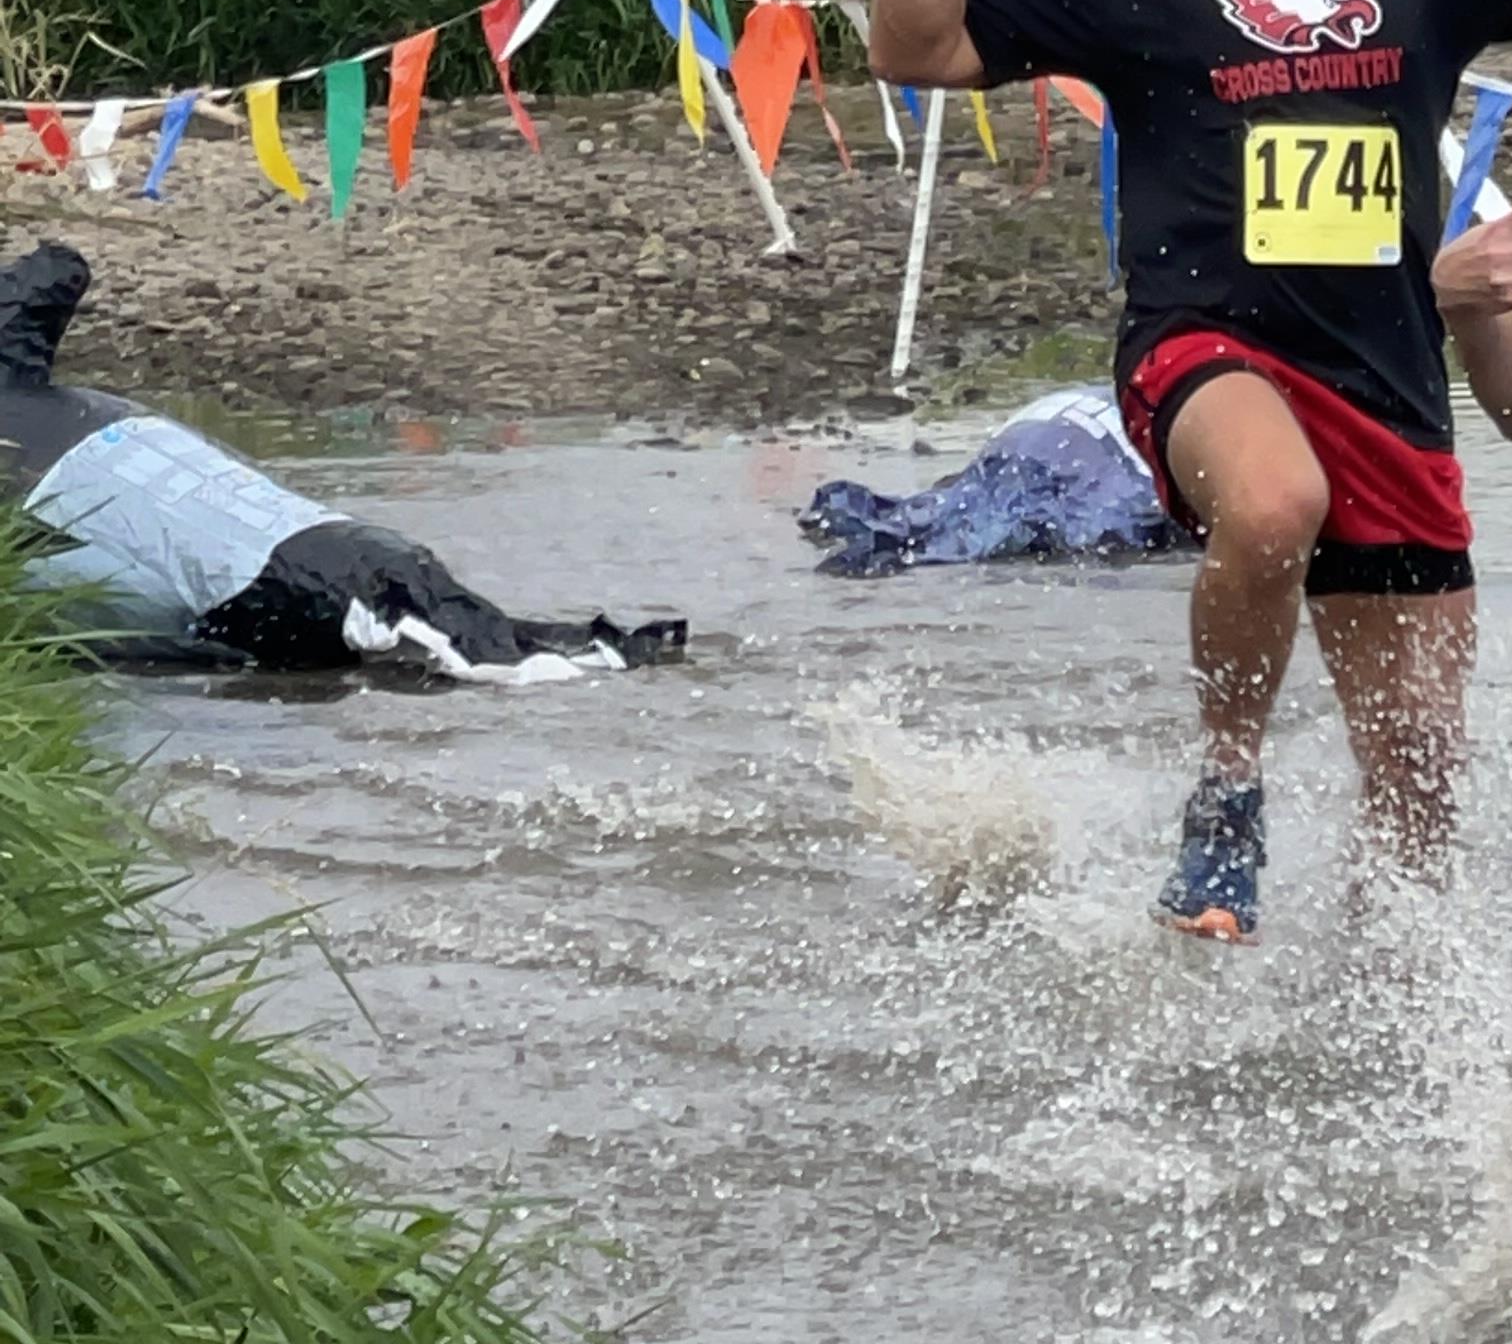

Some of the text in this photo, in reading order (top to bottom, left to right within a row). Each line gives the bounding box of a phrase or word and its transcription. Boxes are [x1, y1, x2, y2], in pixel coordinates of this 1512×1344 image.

[1211, 48, 1403, 103] CROSS COUNTRY
[1256, 138, 1397, 212] 1744
